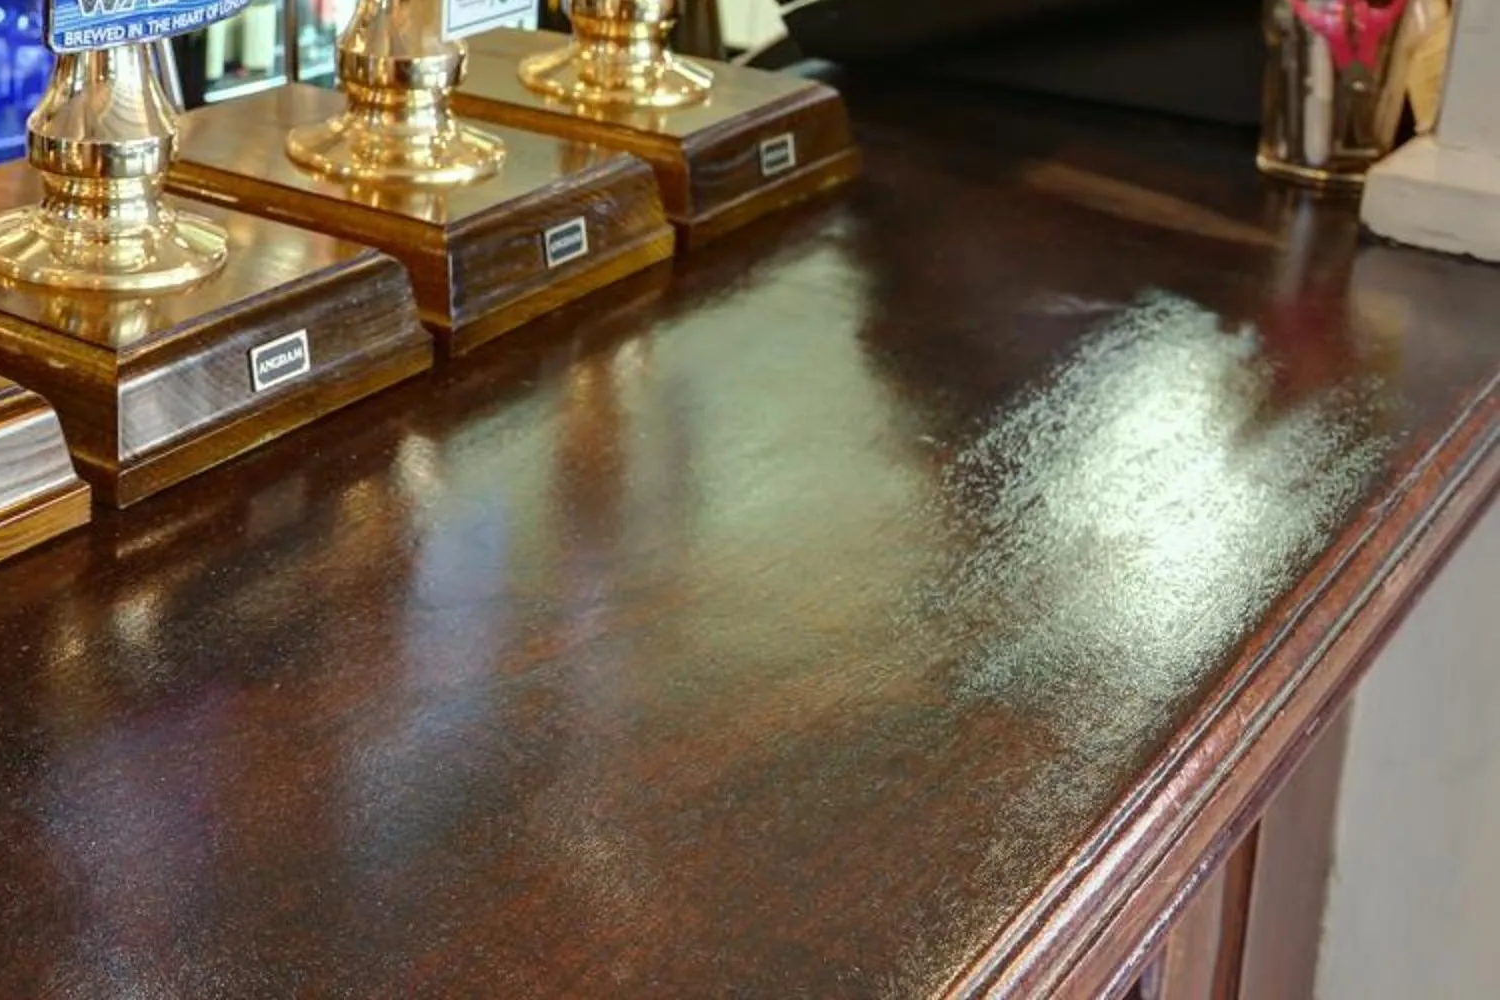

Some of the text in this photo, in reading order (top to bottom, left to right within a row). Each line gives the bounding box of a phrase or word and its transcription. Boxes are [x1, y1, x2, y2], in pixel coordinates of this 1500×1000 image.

[64, 25, 125, 47] BREWED
[127, 22, 142, 38] IN
[148, 16, 171, 34] THE
[172, 10, 204, 31] HEART
[205, 4, 220, 20] OF
